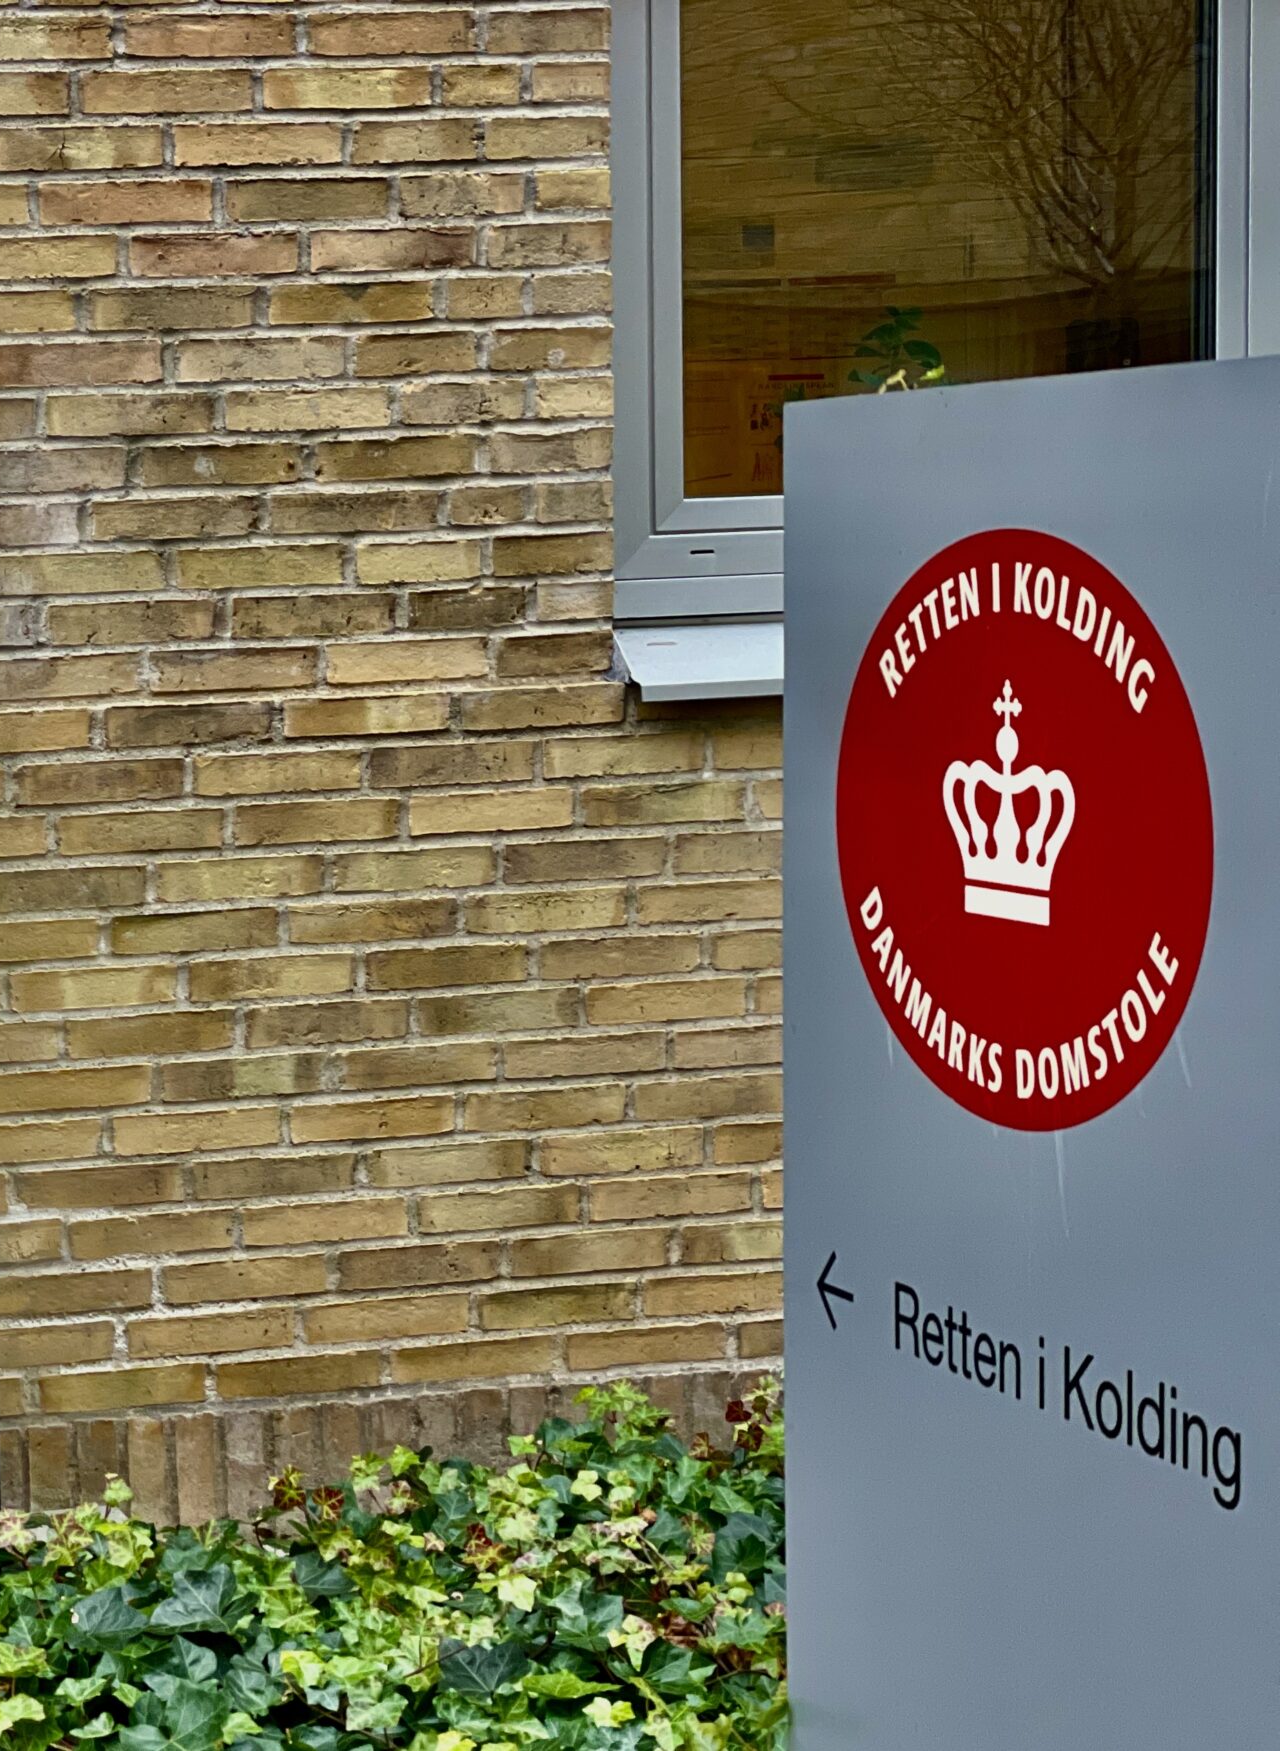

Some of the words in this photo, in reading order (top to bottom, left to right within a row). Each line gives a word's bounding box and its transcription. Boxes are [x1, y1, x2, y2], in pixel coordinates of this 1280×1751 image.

[878, 567, 981, 698] RETTEN
[991, 562, 1001, 613] I
[1013, 561, 1156, 714] KOLDING
[859, 886, 1003, 1093] DANMARKS
[1015, 931, 1179, 1100] DOMSTOLE
[894, 1281, 1021, 1400] Retten
[1037, 1336, 1046, 1410] i
[1063, 1345, 1242, 1511] Kolding
